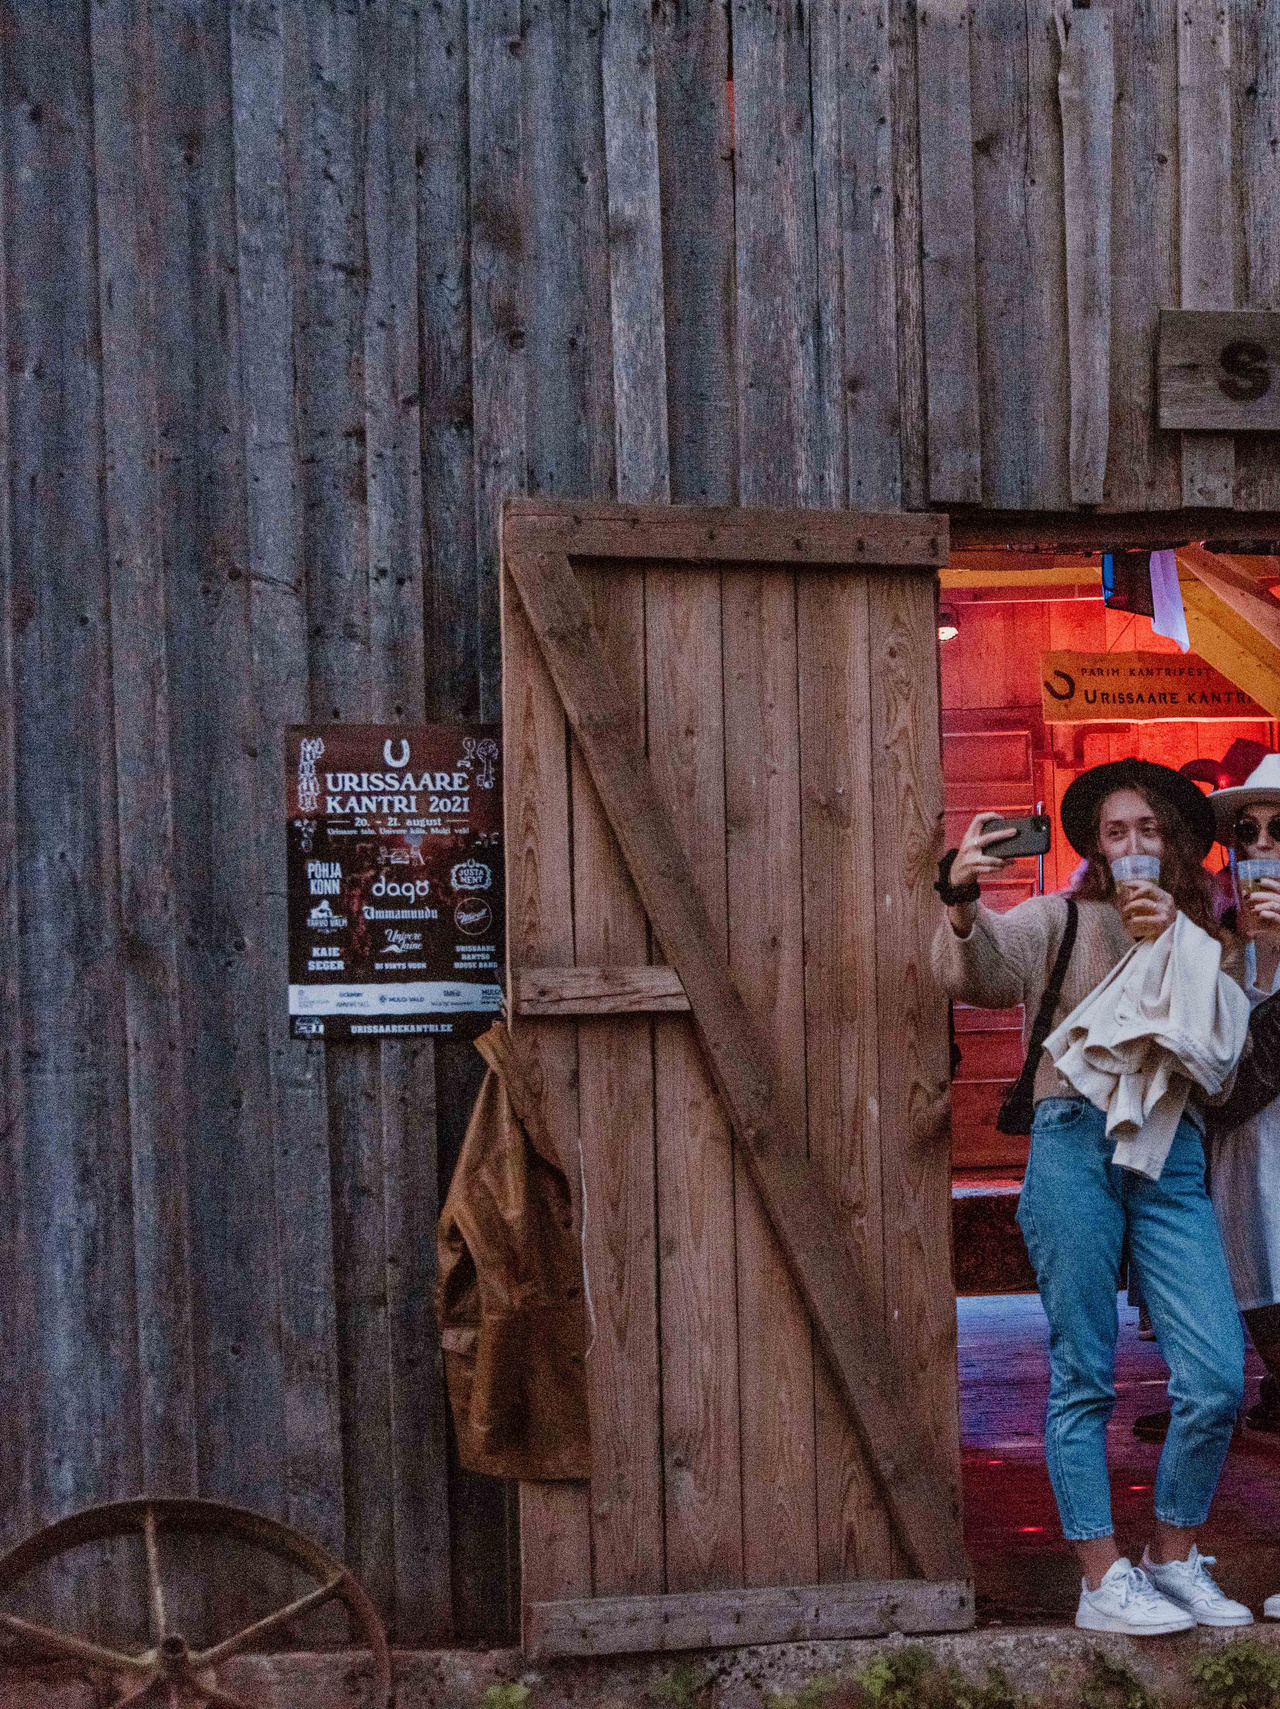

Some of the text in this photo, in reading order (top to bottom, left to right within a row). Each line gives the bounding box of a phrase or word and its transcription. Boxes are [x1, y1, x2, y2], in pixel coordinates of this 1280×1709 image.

[1080, 667, 1120, 677] PARIM
[325, 772, 470, 792] URISSAARE
[325, 795, 470, 814] KANTRI 2021
[354, 816, 370, 827] 20.
[386, 816, 401, 827] 21.
[406, 817, 442, 828] august
[307, 860, 342, 879] PÕHJA
[309, 879, 341, 895] KONN
[312, 946, 341, 957] KAIE
[307, 960, 345, 971] SEGER
